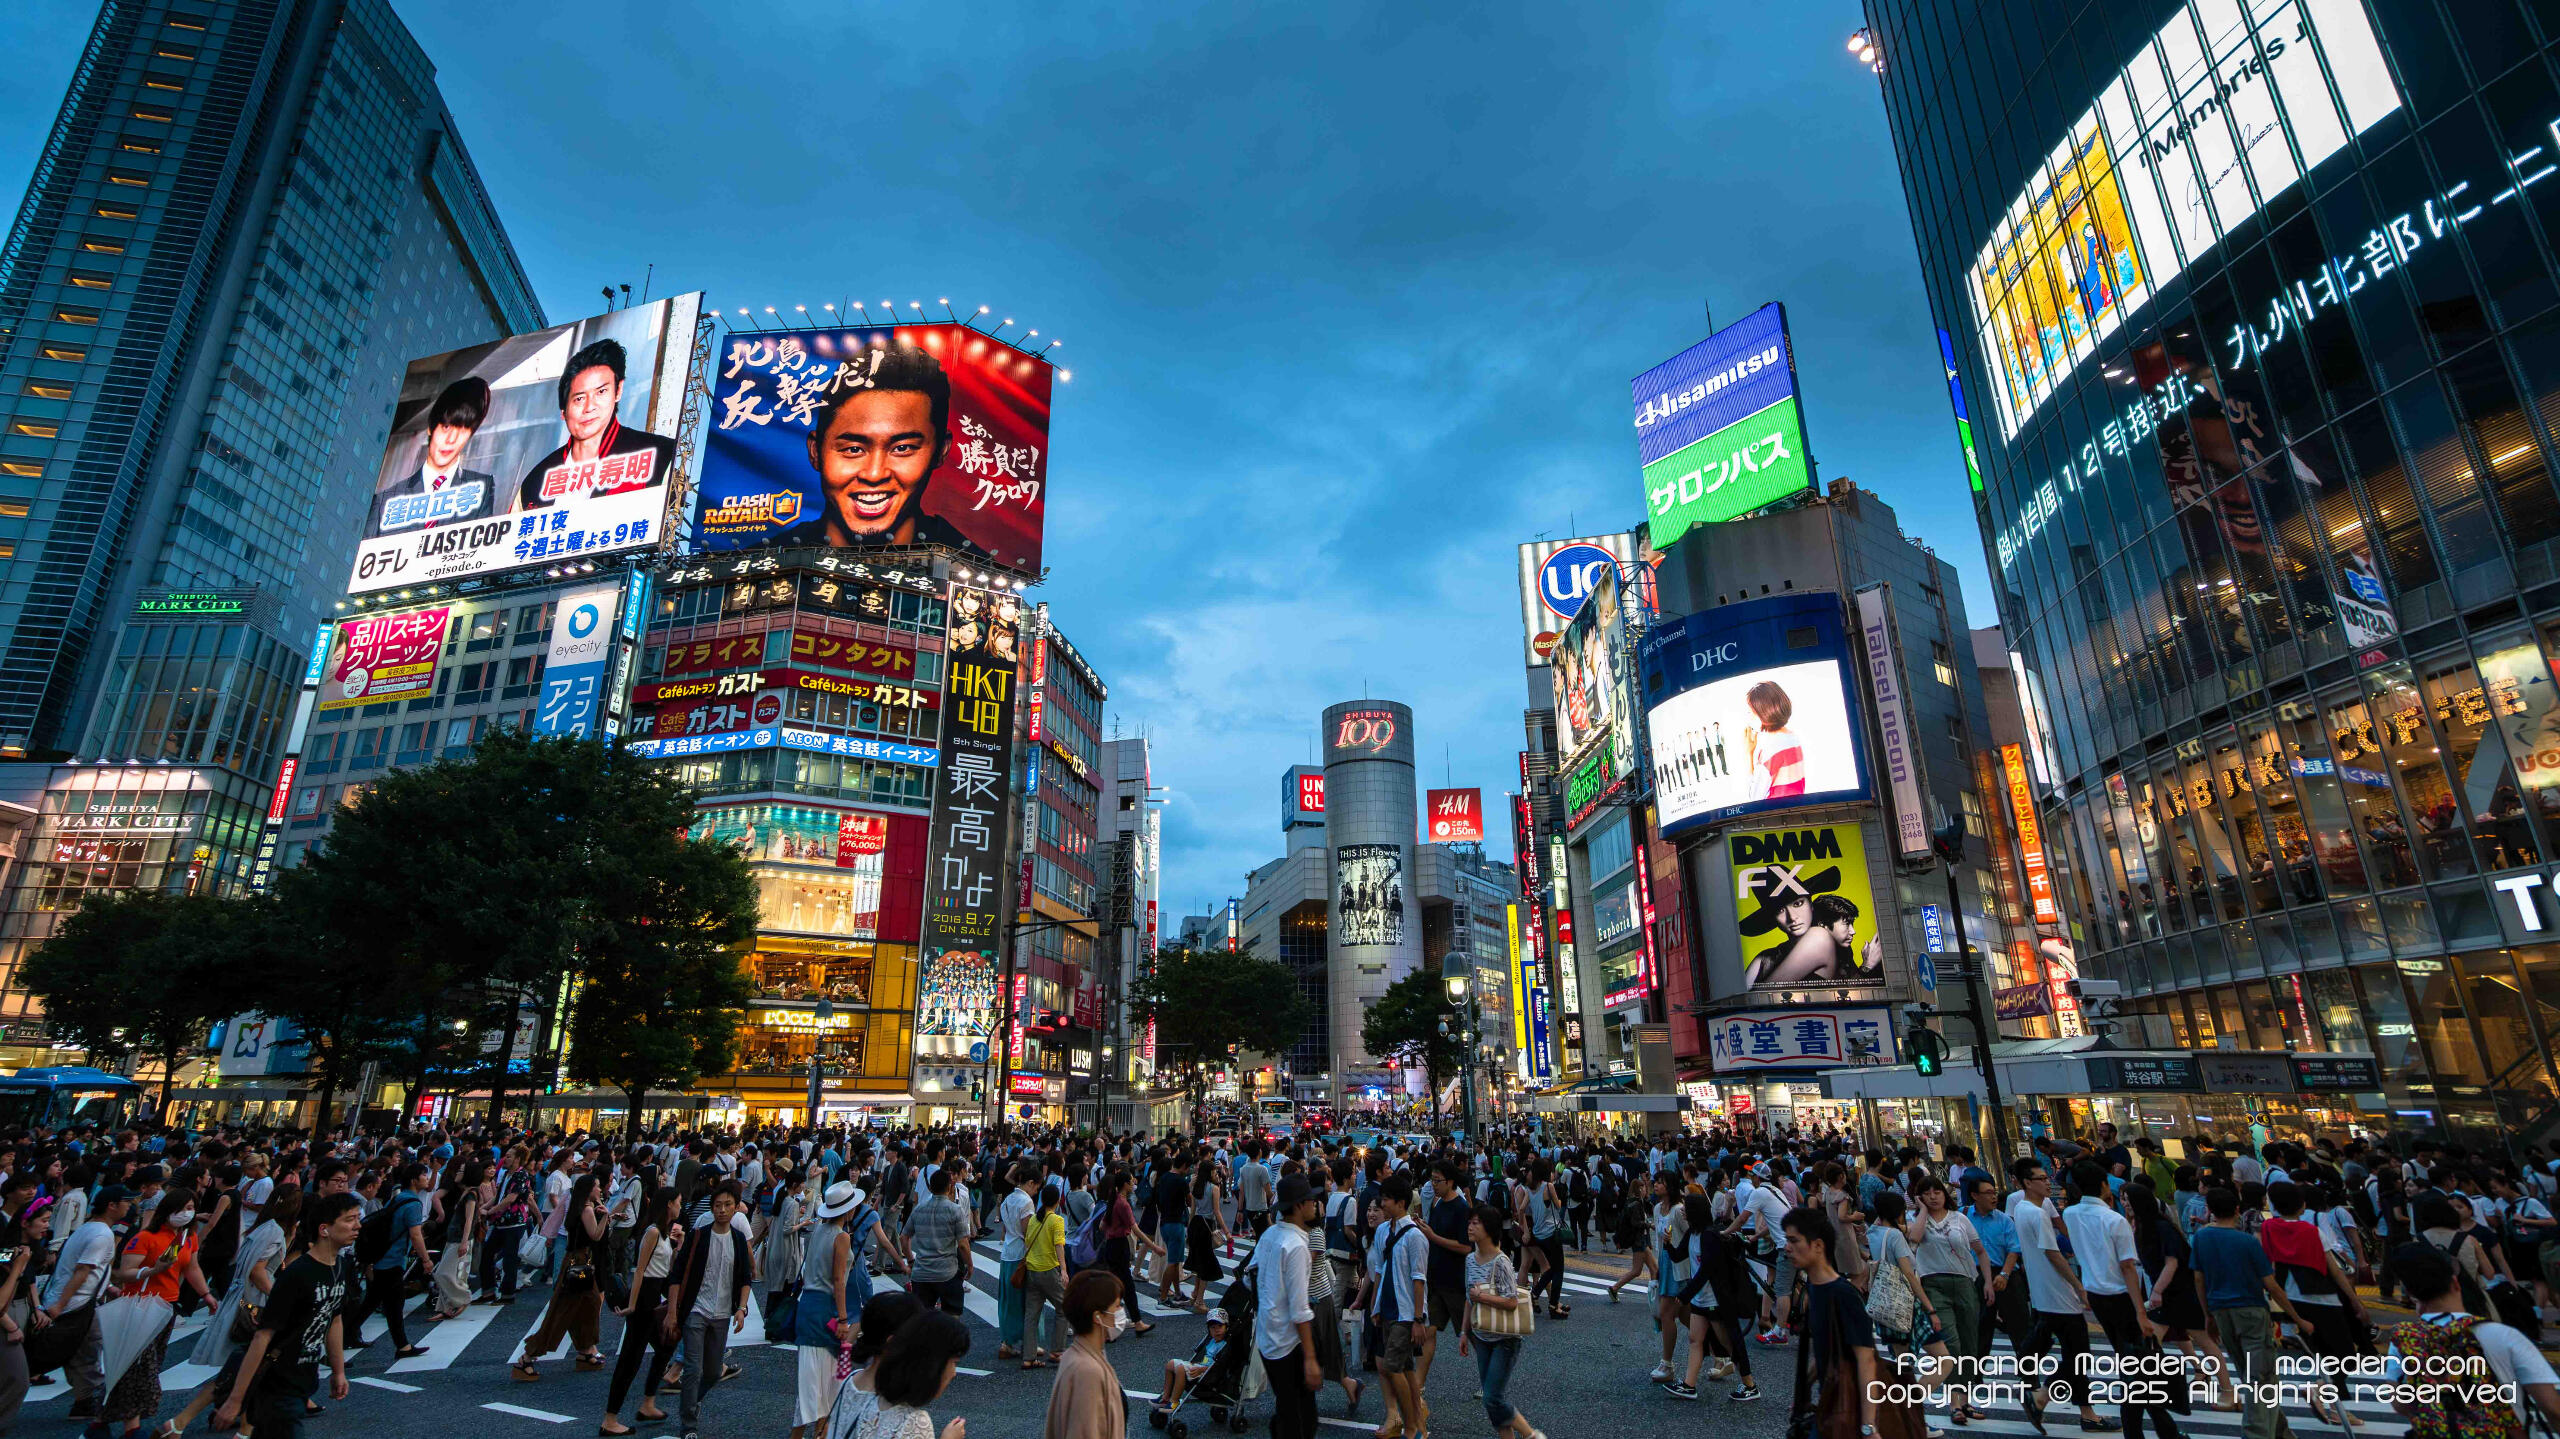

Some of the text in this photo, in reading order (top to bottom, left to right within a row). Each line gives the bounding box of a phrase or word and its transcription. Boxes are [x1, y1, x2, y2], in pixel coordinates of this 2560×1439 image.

[724, 338, 807, 380] 北島
[1634, 345, 1780, 428] Hisamitsu
[956, 441, 1040, 477] 勝負だ!
[541, 448, 657, 500] 唐沢寿明
[1650, 432, 1791, 516] サロンパス
[383, 484, 483, 527] 窪田正孝
[722, 493, 771, 508] CLASH
[970, 478, 1040, 511] クラロワ
[518, 511, 569, 535] 第1夜
[703, 507, 771, 525] ROYALE
[421, 527, 471, 558] LAST
[469, 520, 512, 546] COP
[514, 518, 649, 563] 今週土曜よる9時
[441, 550, 476, 563] ラストコップ
[815, 556, 870, 578] 月の宴
[881, 570, 933, 591] 月の宴
[139, 600, 243, 610] MARK CITY
[811, 580, 885, 613] 月の宴
[350, 614, 446, 648] 品川スキン
[1643, 626, 1686, 657] DHC Channel
[346, 637, 439, 671] クリニック
[555, 639, 602, 657] eyecity
[667, 634, 765, 668] プライス
[793, 633, 913, 671] コンタクト
[1691, 642, 1739, 672] DHC
[347, 685, 362, 695] 4F
[717, 672, 766, 696] ガスト
[950, 661, 1014, 702] HKT
[541, 677, 572, 737] アイ
[568, 675, 596, 741] コンタ
[872, 684, 928, 708] ガスト
[1866, 616, 1907, 783] Taisei neon
[632, 716, 656, 733] 7F
[660, 712, 686, 726] Café
[685, 704, 747, 735] ガスト
[758, 708, 779, 717] ガスト
[957, 700, 1000, 735] 48
[1031, 711, 1041, 736] ガスト
[1345, 711, 1394, 720] SHIBUYA
[663, 733, 751, 755] 英会話イーオン
[756, 733, 769, 743] 6F
[953, 737, 1002, 751] 8th Single
[1335, 718, 1396, 753] 109
[787, 732, 937, 764] AEON 英会話イーオン
[1303, 779, 1324, 793] UN
[88, 804, 158, 813] SHIBUYA
[1304, 794, 1324, 810] QL
[1438, 795, 1470, 816] H&M
[1726, 806, 1745, 816] DHC
[49, 815, 198, 828] MARK CITY
[841, 820, 869, 834] 沖縄
[941, 752, 1003, 908] 最高かよ
[1451, 820, 1470, 828] この先
[1900, 813, 1919, 823] (03)
[1901, 821, 1921, 831] 3719
[1452, 826, 1477, 836] 150m
[1902, 829, 1922, 839] 2468
[2005, 748, 2055, 914] クスリのことなら 三千里
[1340, 847, 1399, 859] THIS IS Flower
[1730, 828, 1843, 866] DMM
[1738, 863, 1810, 898] FX
[2494, 874, 2560, 931] T
[939, 924, 991, 937] ON SALE
[1597, 914, 1631, 943] Euphoria
[1535, 994, 1543, 1022] MIZUHO
[1714, 1020, 1881, 1060] 大盛堂書店
[1071, 1048, 1092, 1069] LUSH
[2125, 1071, 2166, 1086] 渋谷駅
